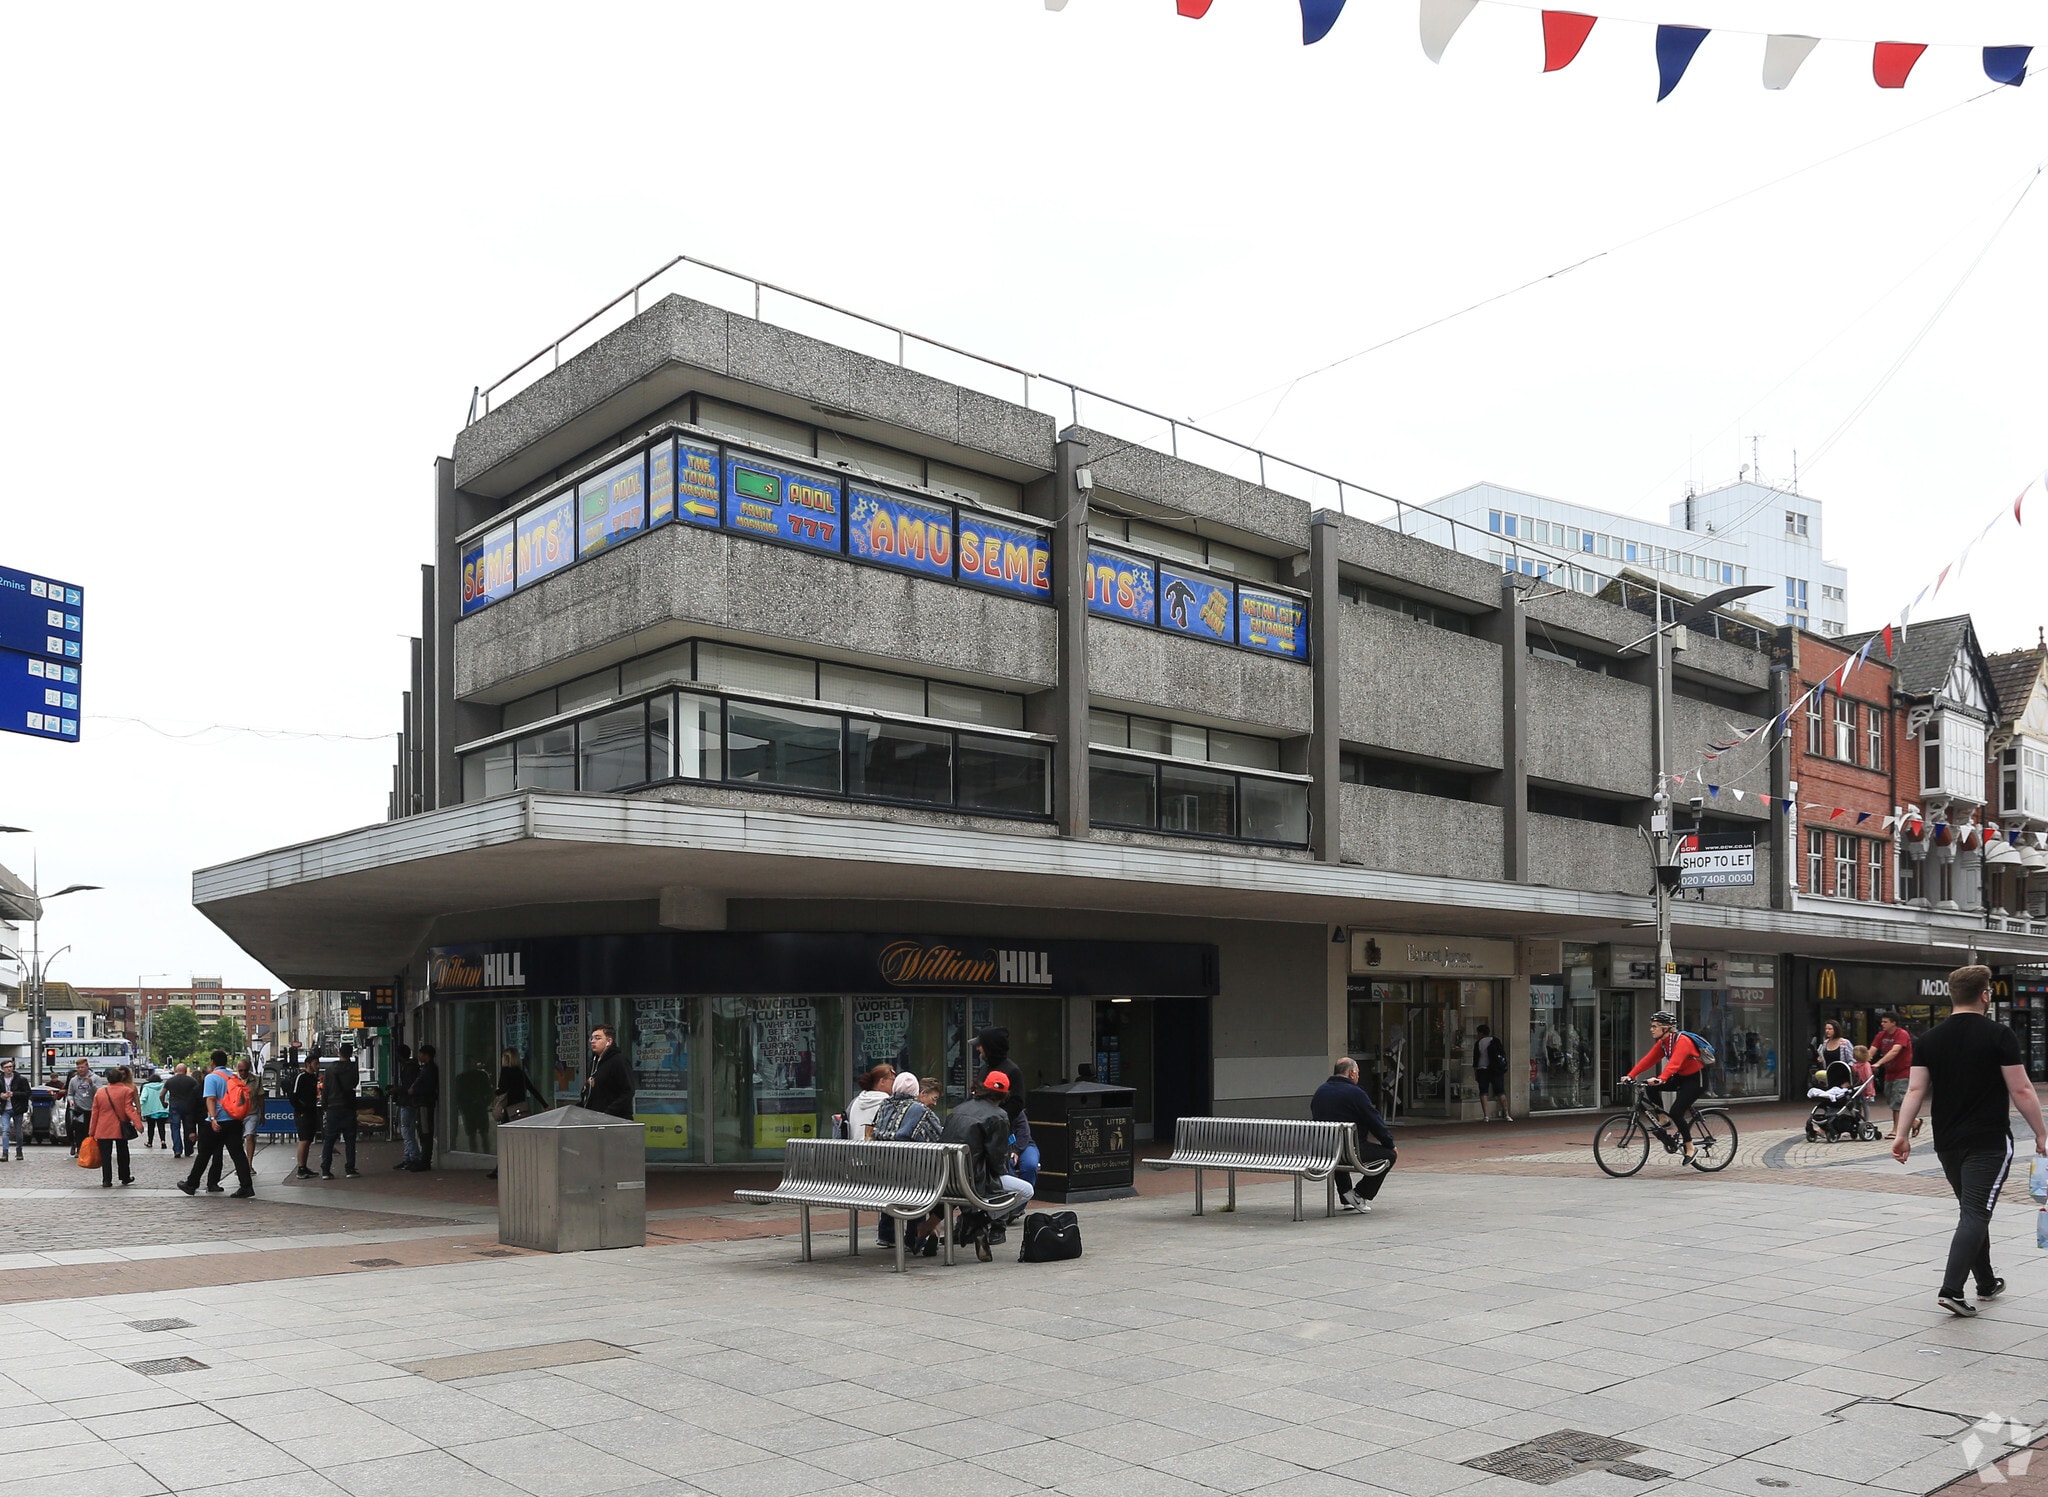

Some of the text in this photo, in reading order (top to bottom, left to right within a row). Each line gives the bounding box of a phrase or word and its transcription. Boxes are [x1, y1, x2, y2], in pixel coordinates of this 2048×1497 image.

[687, 454, 711, 472] THE
[682, 468, 717, 488] TOWN
[613, 472, 641, 504] POOL
[680, 483, 719, 501] ARCADE
[788, 483, 835, 514] POOL
[741, 502, 773, 520] FRUIT
[612, 506, 641, 536] 777
[736, 515, 779, 535] MACHINES
[788, 515, 835, 541] 777
[1242, 598, 1303, 627] ASTRO CITY
[1250, 618, 1294, 641] ENTRANCE
[1683, 854, 1751, 869] SHOP TO LET
[1681, 873, 1753, 885] 020 7408 0030
[878, 940, 1052, 984] William HILL
[432, 952, 525, 989] William HILL
[1921, 979, 1951, 996] McDo
[637, 1000, 660, 1010] GET
[760, 998, 808, 1009] WORLD
[858, 1001, 901, 1011] WORLD
[556, 1016, 572, 1025] CUP
[757, 1009, 811, 1021] CUP BET
[856, 1011, 905, 1022] CUP BET
[863, 1022, 887, 1030] WHEN
[760, 1042, 795, 1050] EUROPA
[764, 1049, 798, 1057] LEAGUE
[264, 1112, 295, 1120] GREGG
[1106, 1118, 1126, 1126] LITTER
[1075, 1128, 1099, 1136] PLASTIC
[1074, 1140, 1099, 1149] BOTTLES
